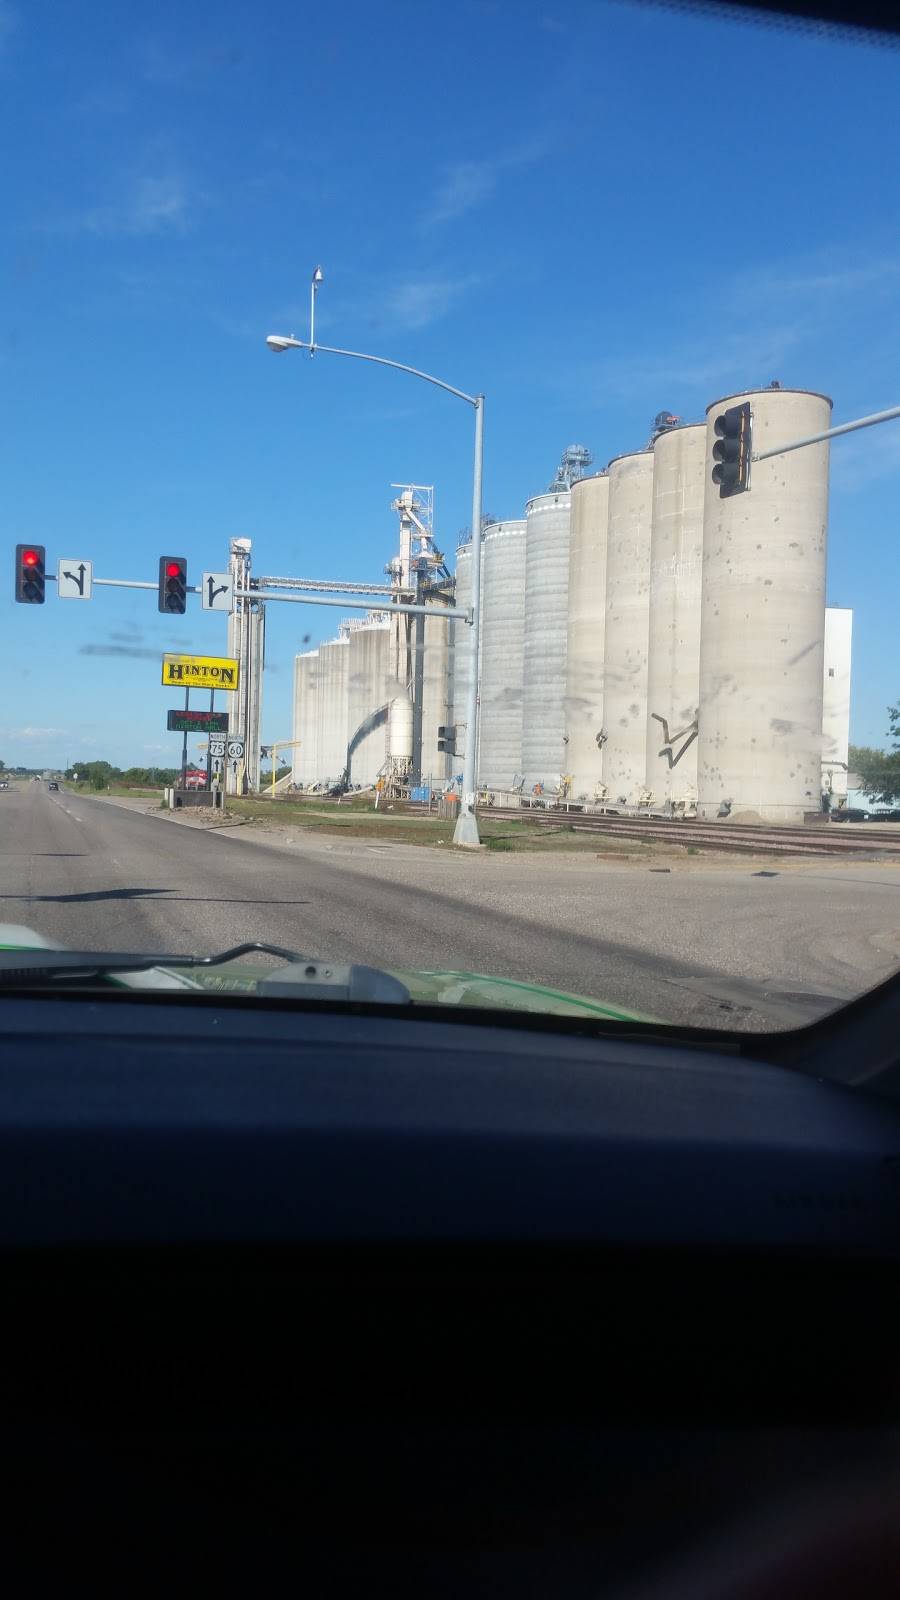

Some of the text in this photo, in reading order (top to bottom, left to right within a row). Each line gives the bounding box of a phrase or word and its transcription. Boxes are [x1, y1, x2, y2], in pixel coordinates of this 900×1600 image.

[168, 664, 234, 683] HINTON
[212, 744, 223, 754] 75
[229, 745, 242, 755] 60
